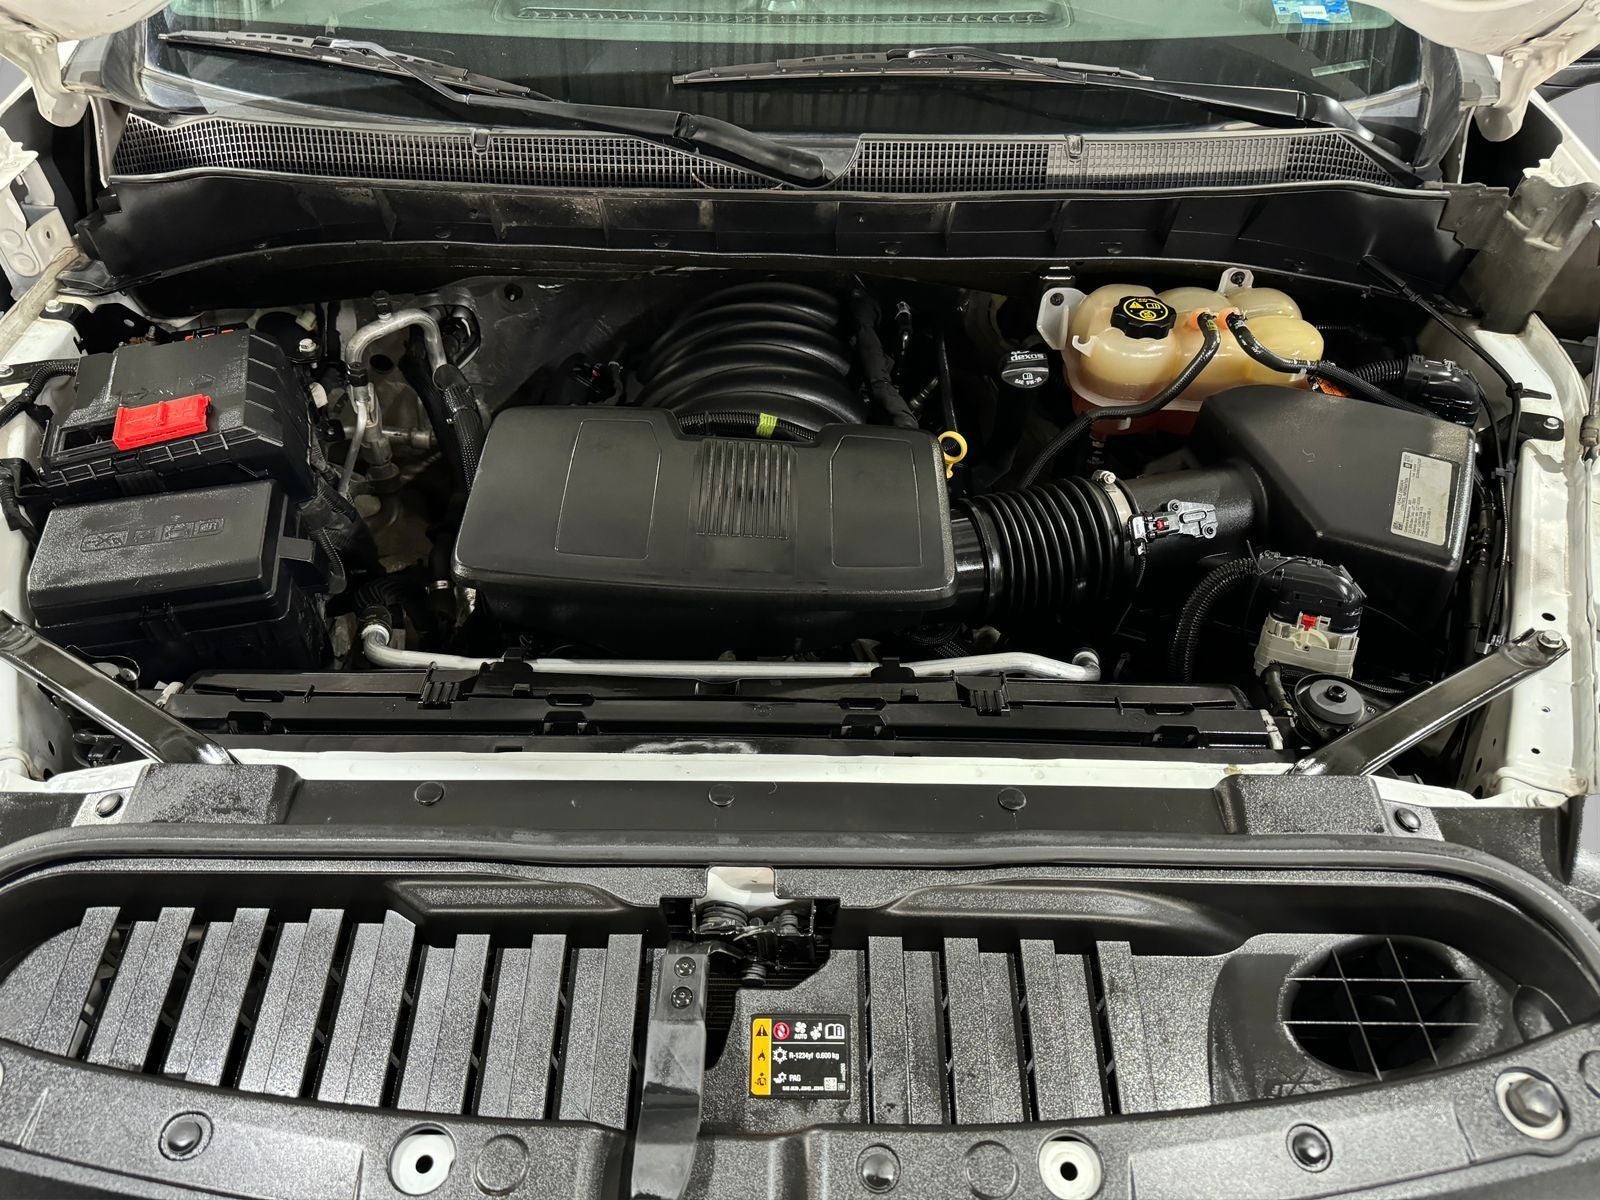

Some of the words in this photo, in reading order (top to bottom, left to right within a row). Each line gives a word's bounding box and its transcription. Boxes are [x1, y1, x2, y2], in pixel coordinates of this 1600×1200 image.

[1010, 353, 1044, 361] dexos
[789, 1052, 813, 1060] R-1234yf
[832, 1052, 840, 1060] kg
[789, 1074, 801, 1082] PAG
